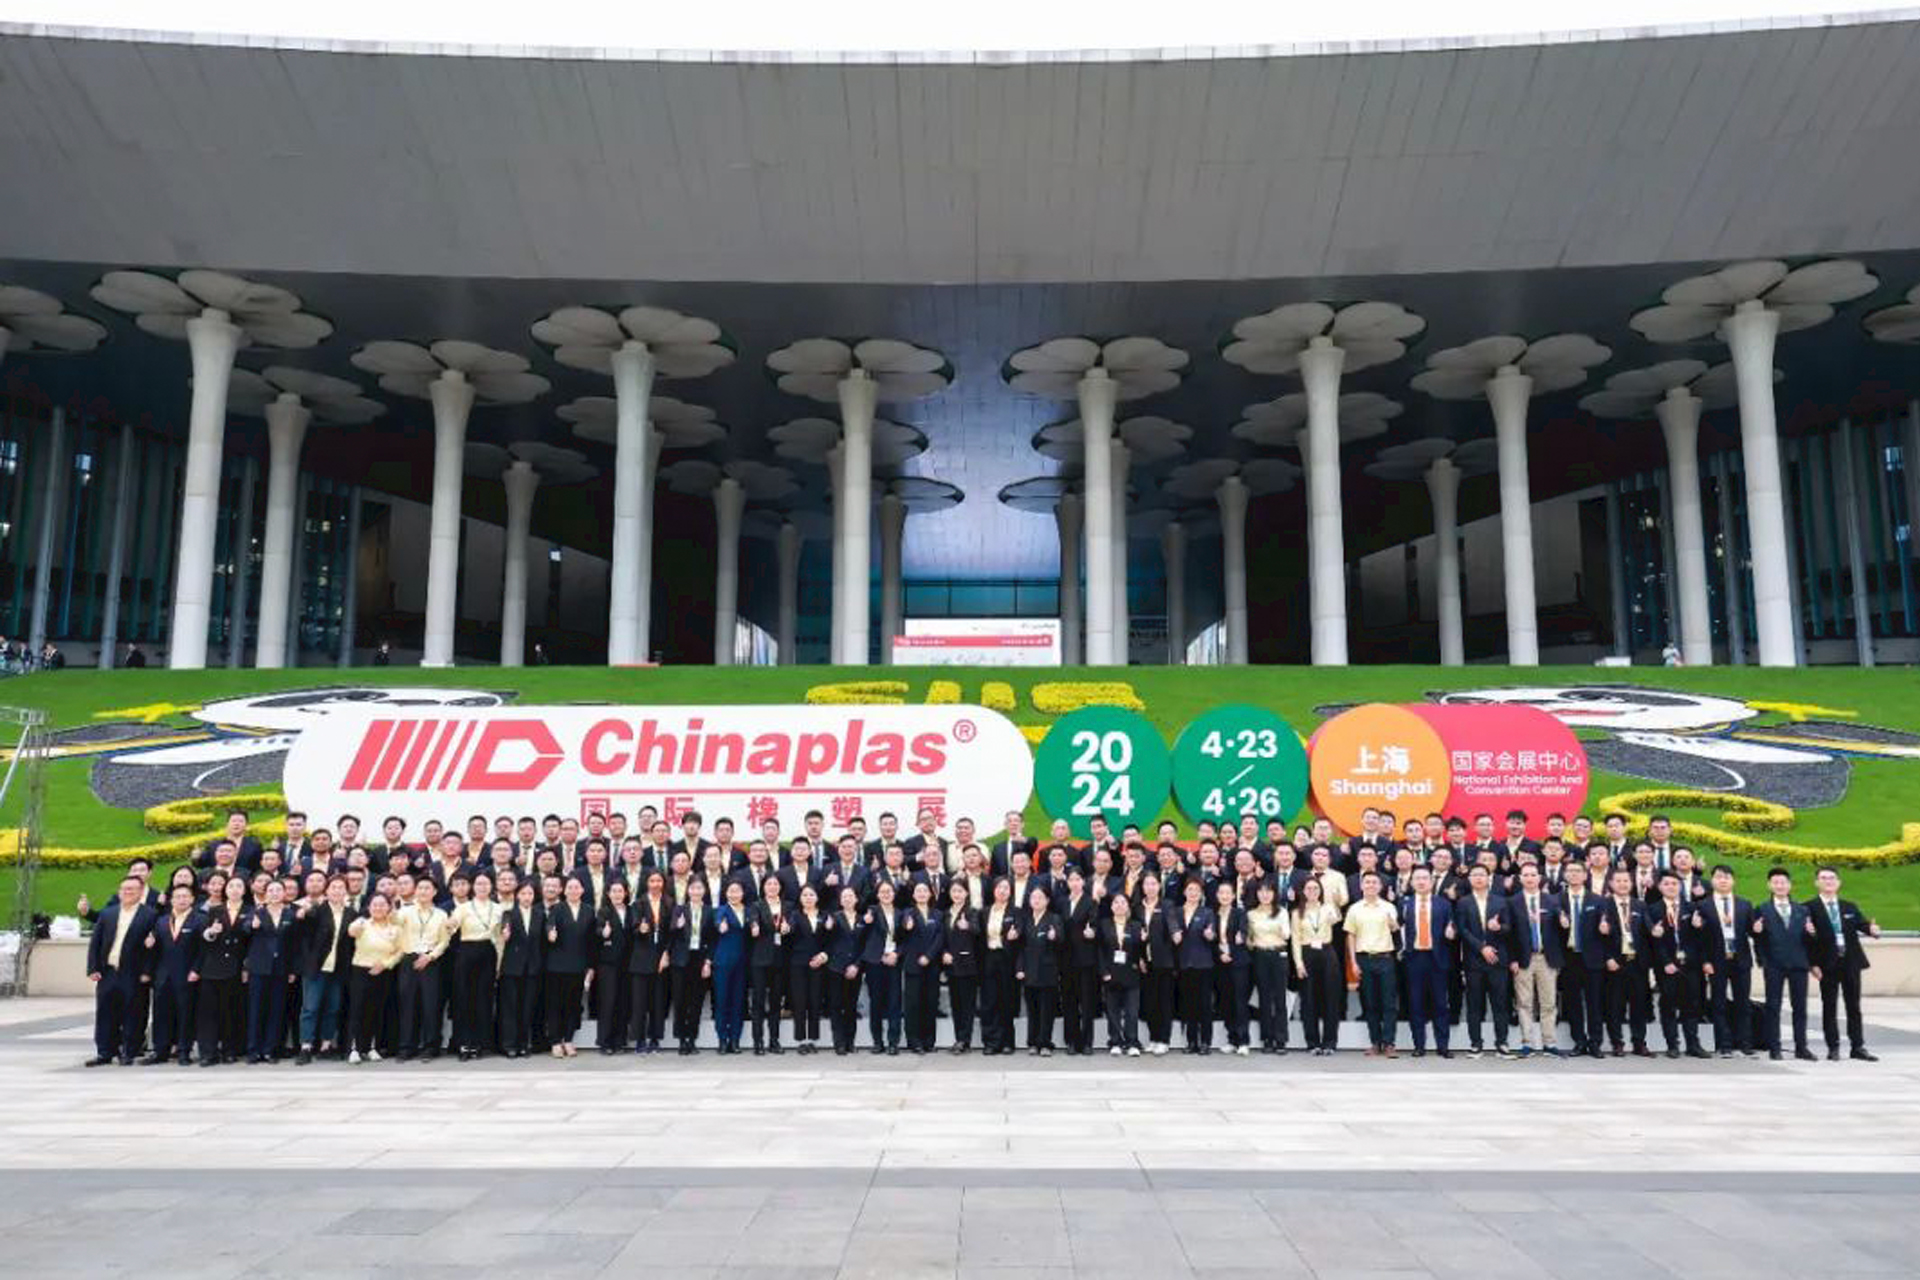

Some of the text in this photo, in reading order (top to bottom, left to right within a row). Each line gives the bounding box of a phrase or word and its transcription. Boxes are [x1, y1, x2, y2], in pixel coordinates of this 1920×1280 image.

[580, 718, 948, 787] Chinaplas
[1071, 730, 1133, 773] 20
[1350, 745, 1411, 775] 上海
[1451, 750, 1581, 771] 国家会展中心
[1330, 778, 1433, 801] Shanghai
[1453, 774, 1583, 785] National Exhibition And
[1465, 785, 1572, 796] Convention Center
[1071, 773, 1135, 816] 24
